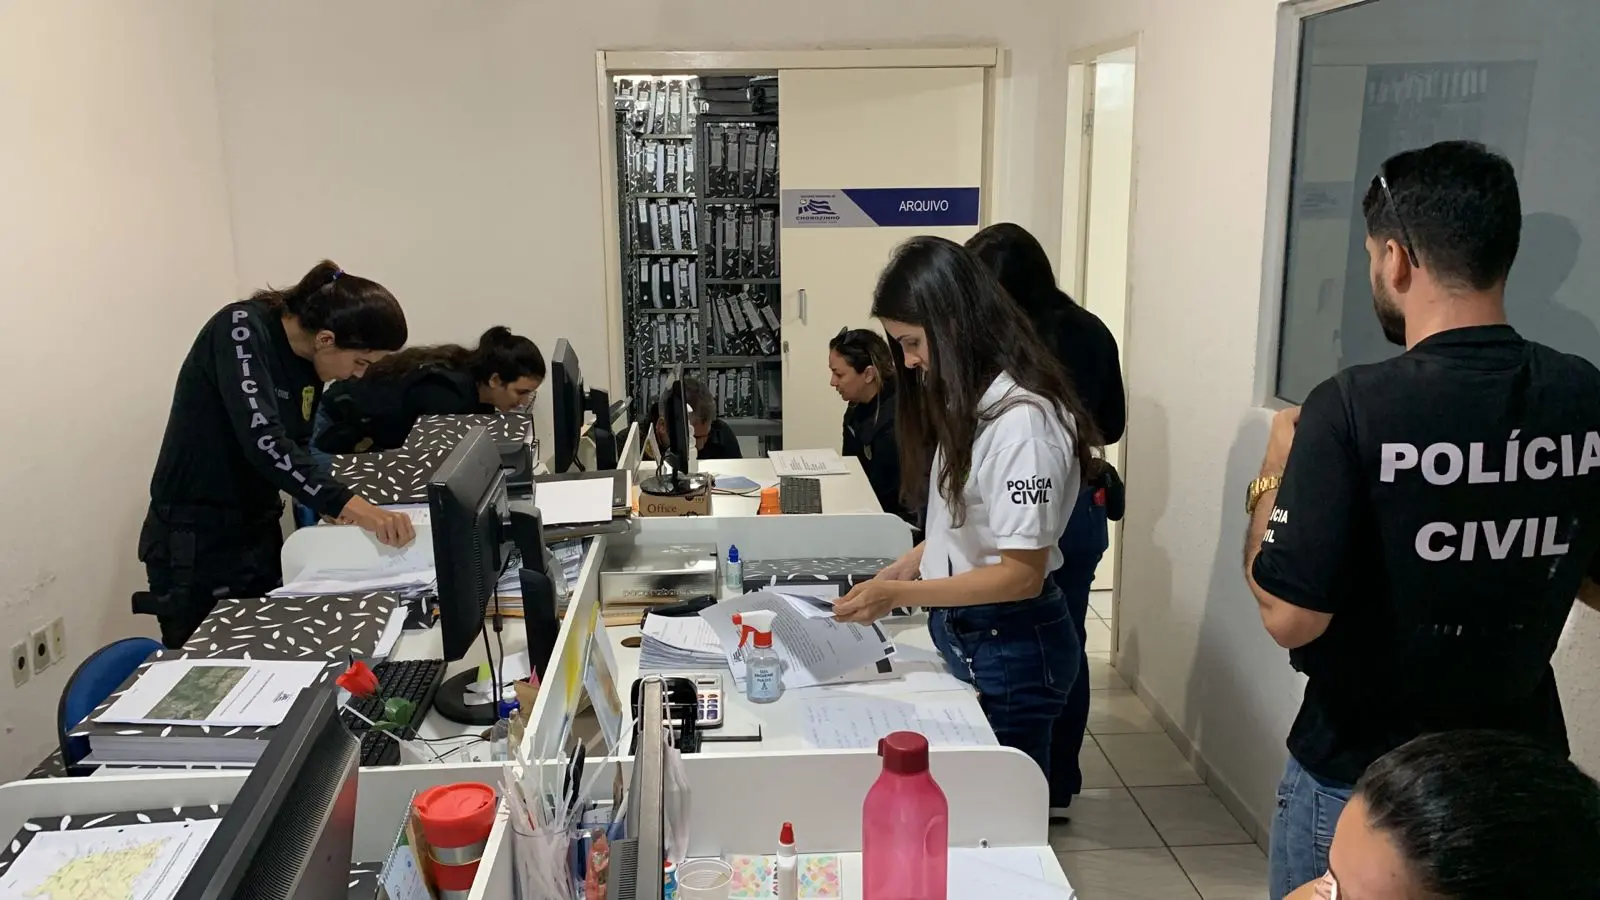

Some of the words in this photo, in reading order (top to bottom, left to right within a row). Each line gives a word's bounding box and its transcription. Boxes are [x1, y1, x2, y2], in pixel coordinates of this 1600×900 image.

[899, 200, 949, 212] ARQUIVO
[231, 310, 270, 428] POLÍCIA
[257, 435, 323, 496] CIVIL
[1379, 429, 1600, 486] POLÍCIA
[1006, 475, 1052, 491] POLÍCIA
[1011, 490, 1050, 505] CIVIL
[647, 503, 677, 513] Office
[1414, 516, 1570, 562] CIVIL
